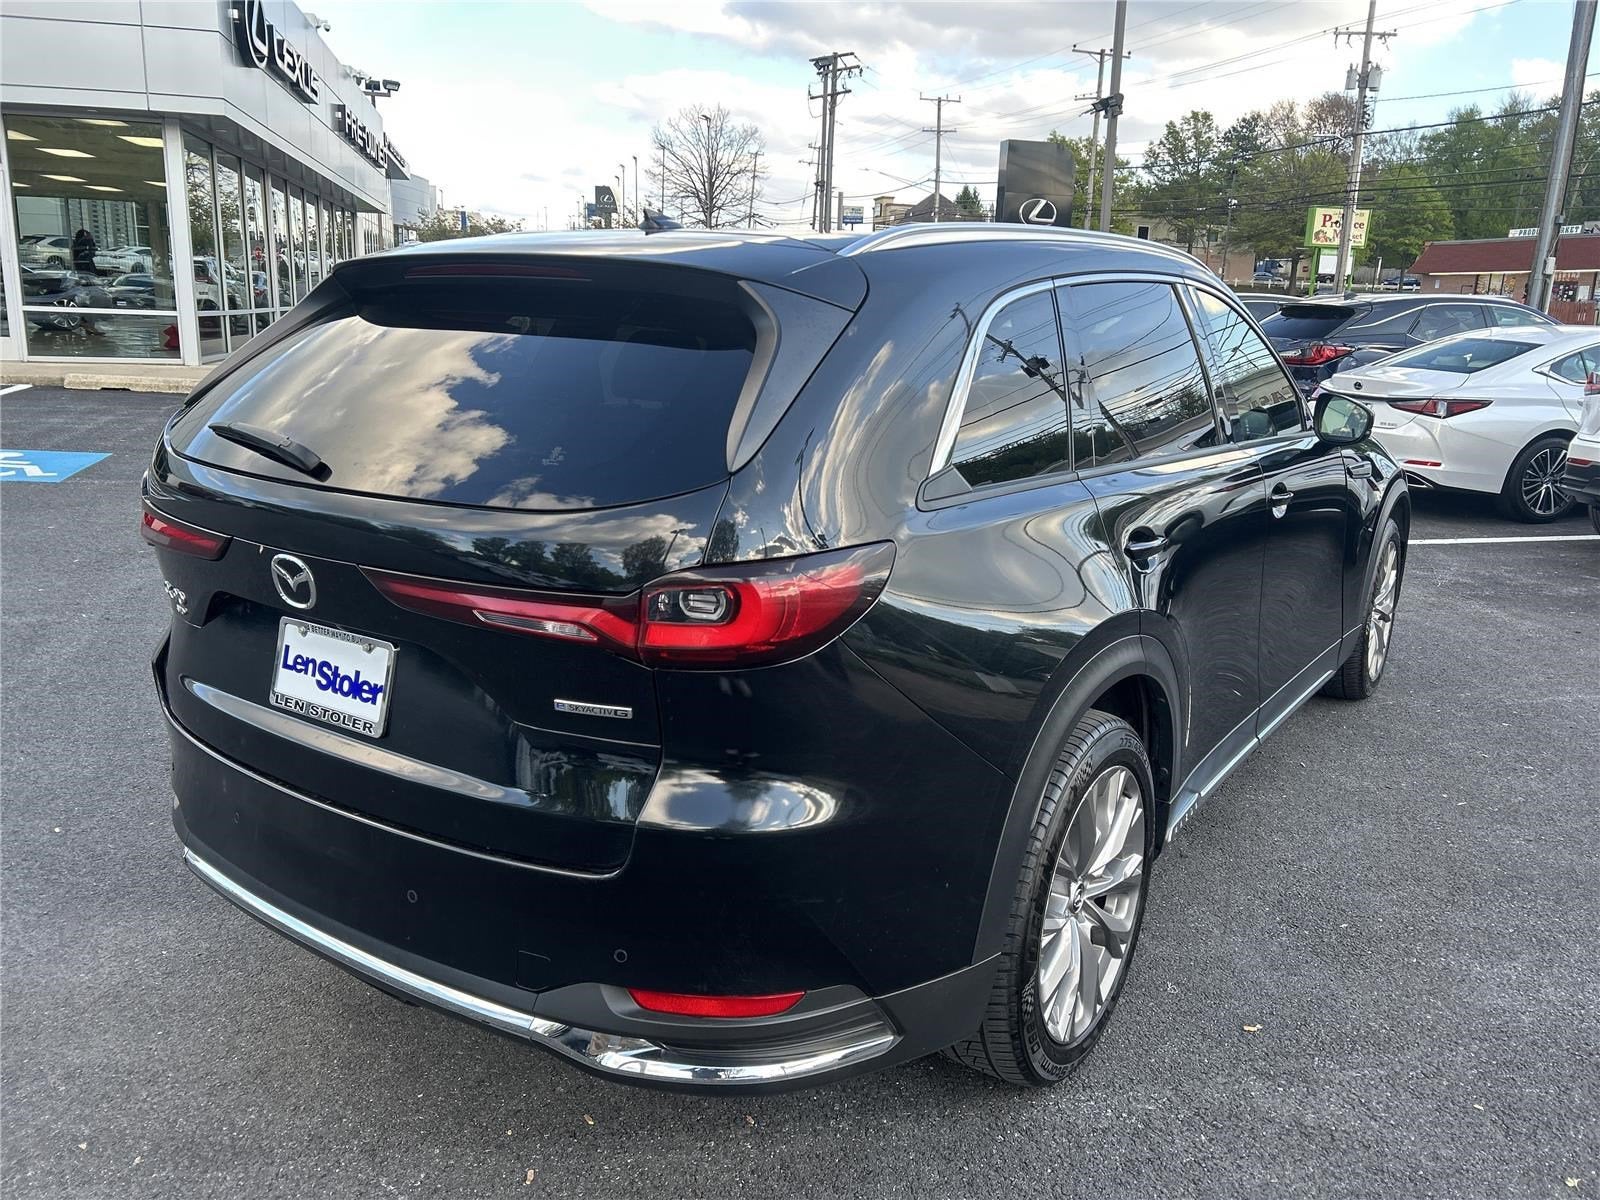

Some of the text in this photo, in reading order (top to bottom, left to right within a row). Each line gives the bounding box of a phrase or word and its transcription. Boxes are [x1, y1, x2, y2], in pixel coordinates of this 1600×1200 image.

[270, 24, 320, 105] LEXUS
[1321, 213, 1365, 229] Proce
[311, 624, 330, 636] BETTER
[331, 629, 343, 639] WAY
[275, 694, 375, 734] LEN STOLER
[569, 704, 612, 715] SKYACTIV
